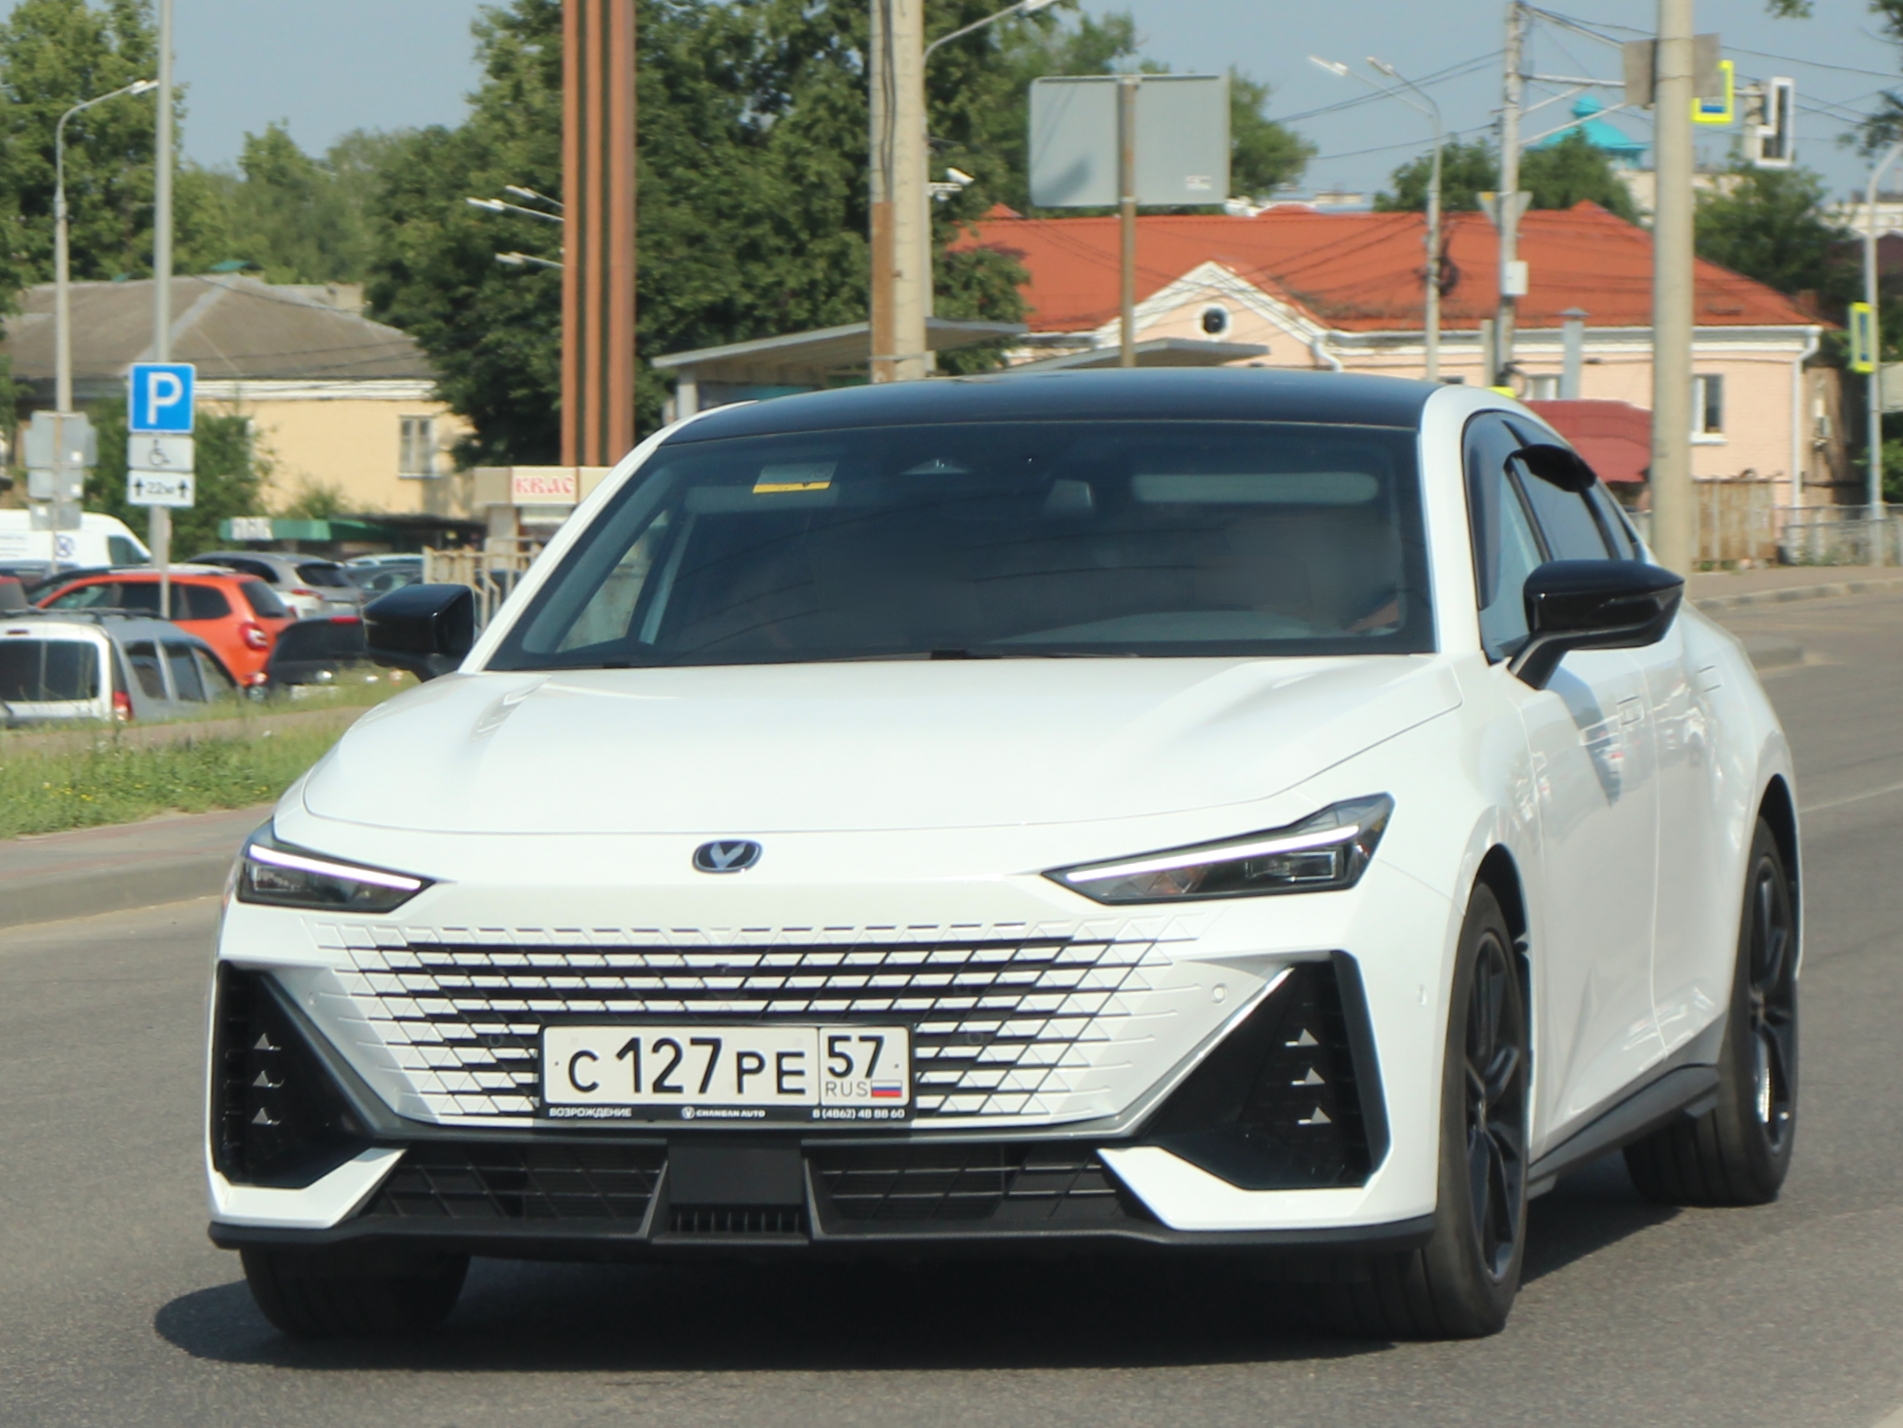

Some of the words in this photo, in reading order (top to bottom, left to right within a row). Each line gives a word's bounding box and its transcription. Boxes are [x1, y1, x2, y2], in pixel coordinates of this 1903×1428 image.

[147, 371, 184, 425] P
[514, 476, 575, 494] КВАС
[827, 1035, 885, 1079] 57
[825, 1080, 869, 1097] RUS
[549, 1107, 632, 1118] ВОЗРОЖДЕНИЕ
[696, 1109, 740, 1118] CHANGAN
[741, 1109, 767, 1118] AUTO
[812, 1108, 821, 1119] 8
